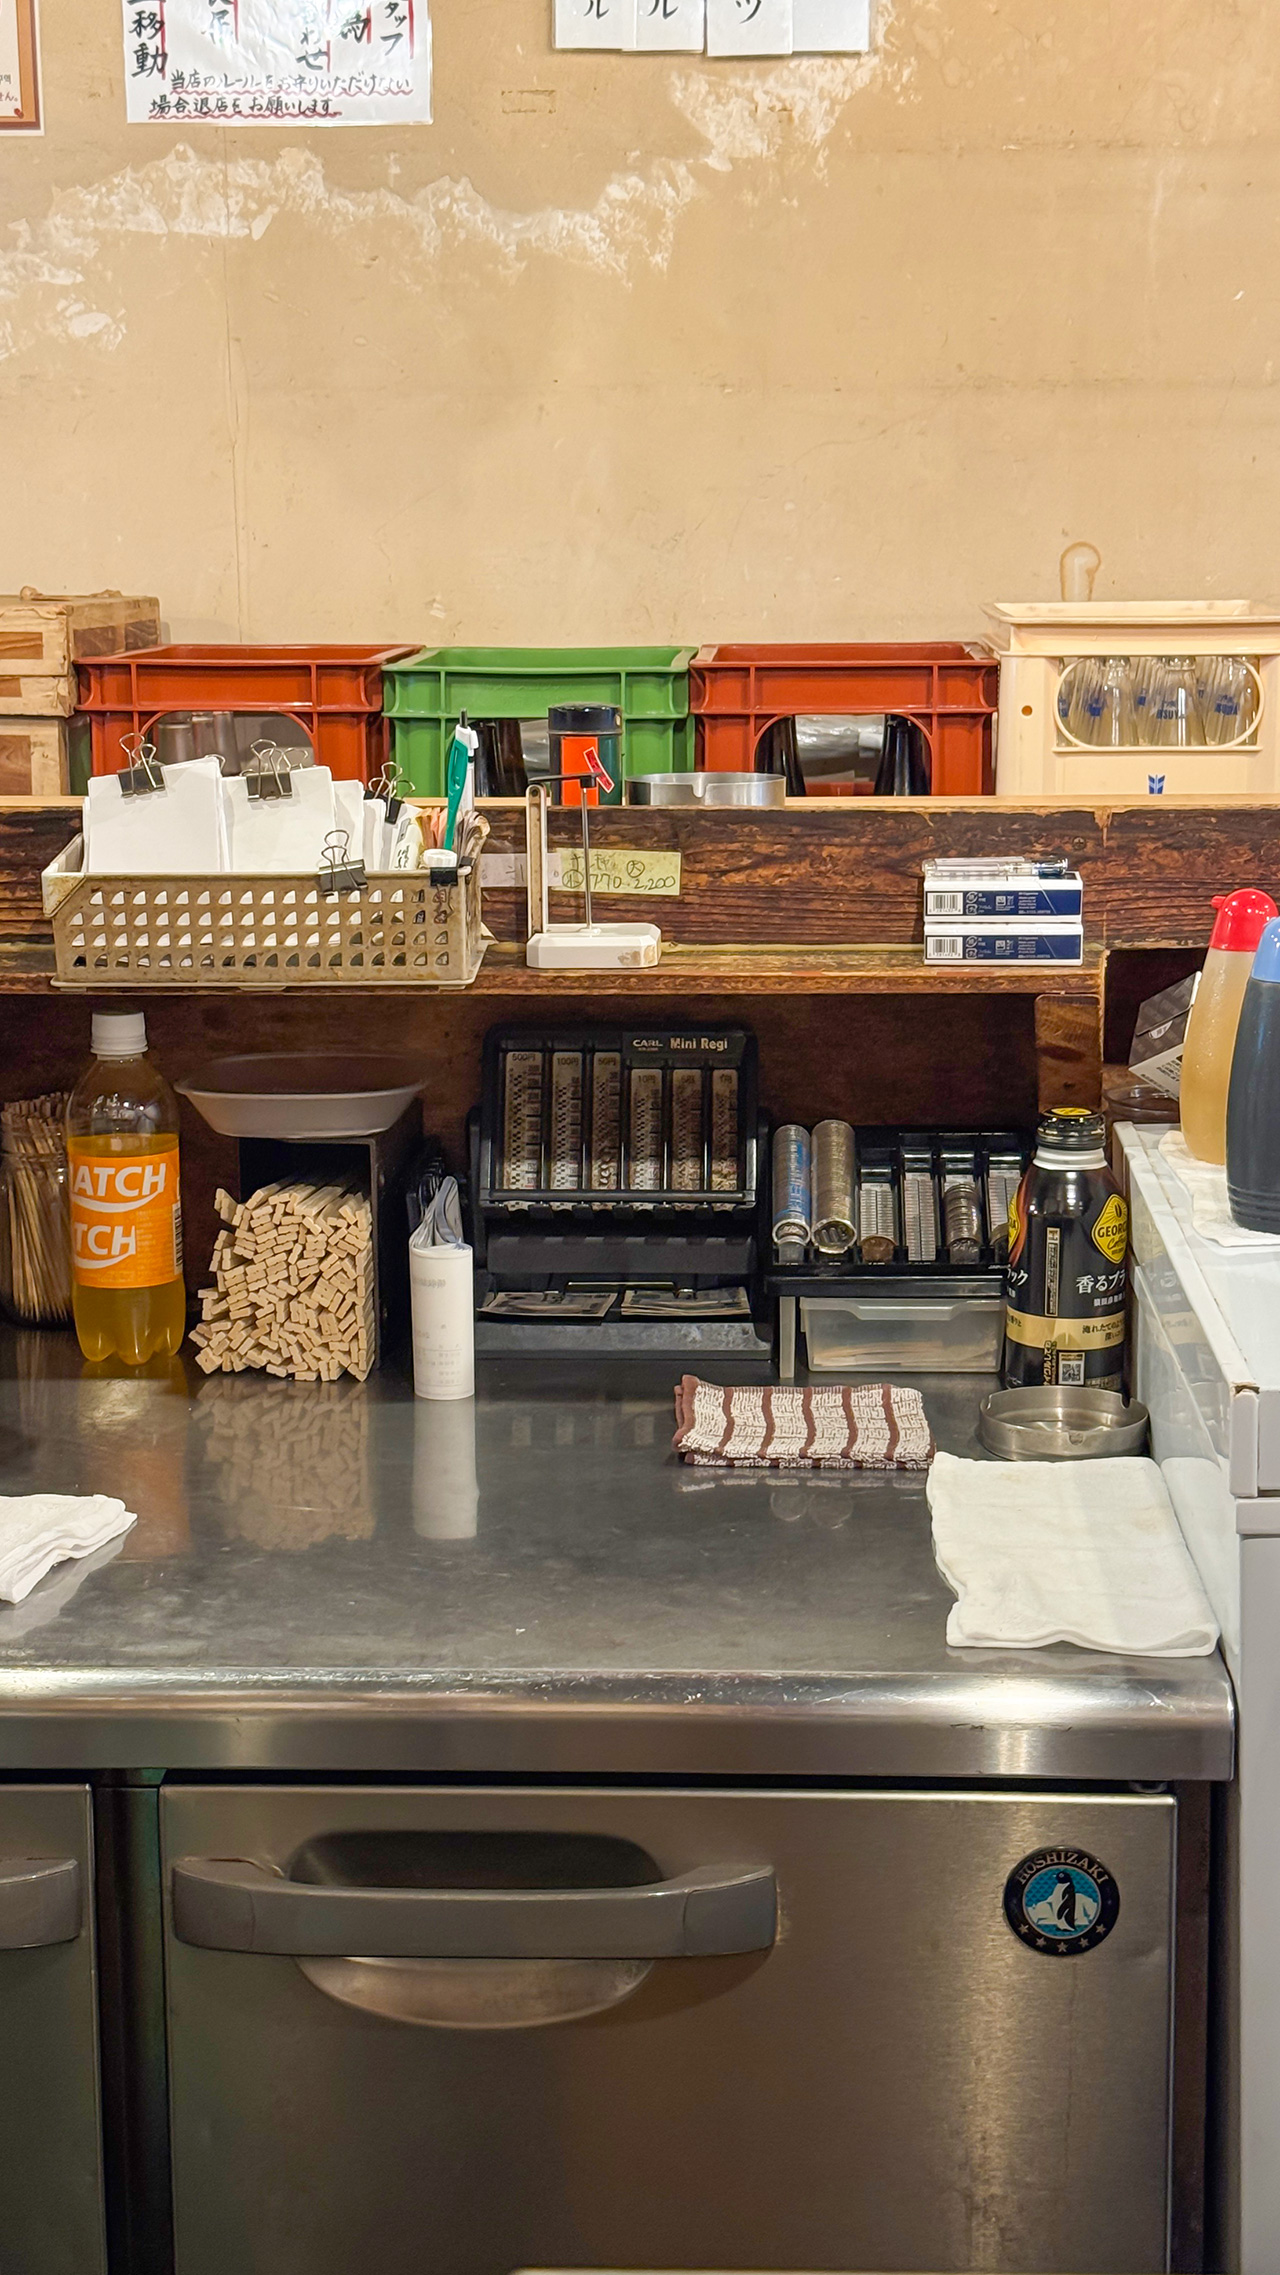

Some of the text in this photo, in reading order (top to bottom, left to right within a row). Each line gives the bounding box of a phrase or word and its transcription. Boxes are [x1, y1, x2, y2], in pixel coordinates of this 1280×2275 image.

[127, 0, 168, 78] 移動
[632, 1037, 728, 1051] CARL Mini Regi
[1016, 1851, 1109, 1885] HOSHIZAKI
